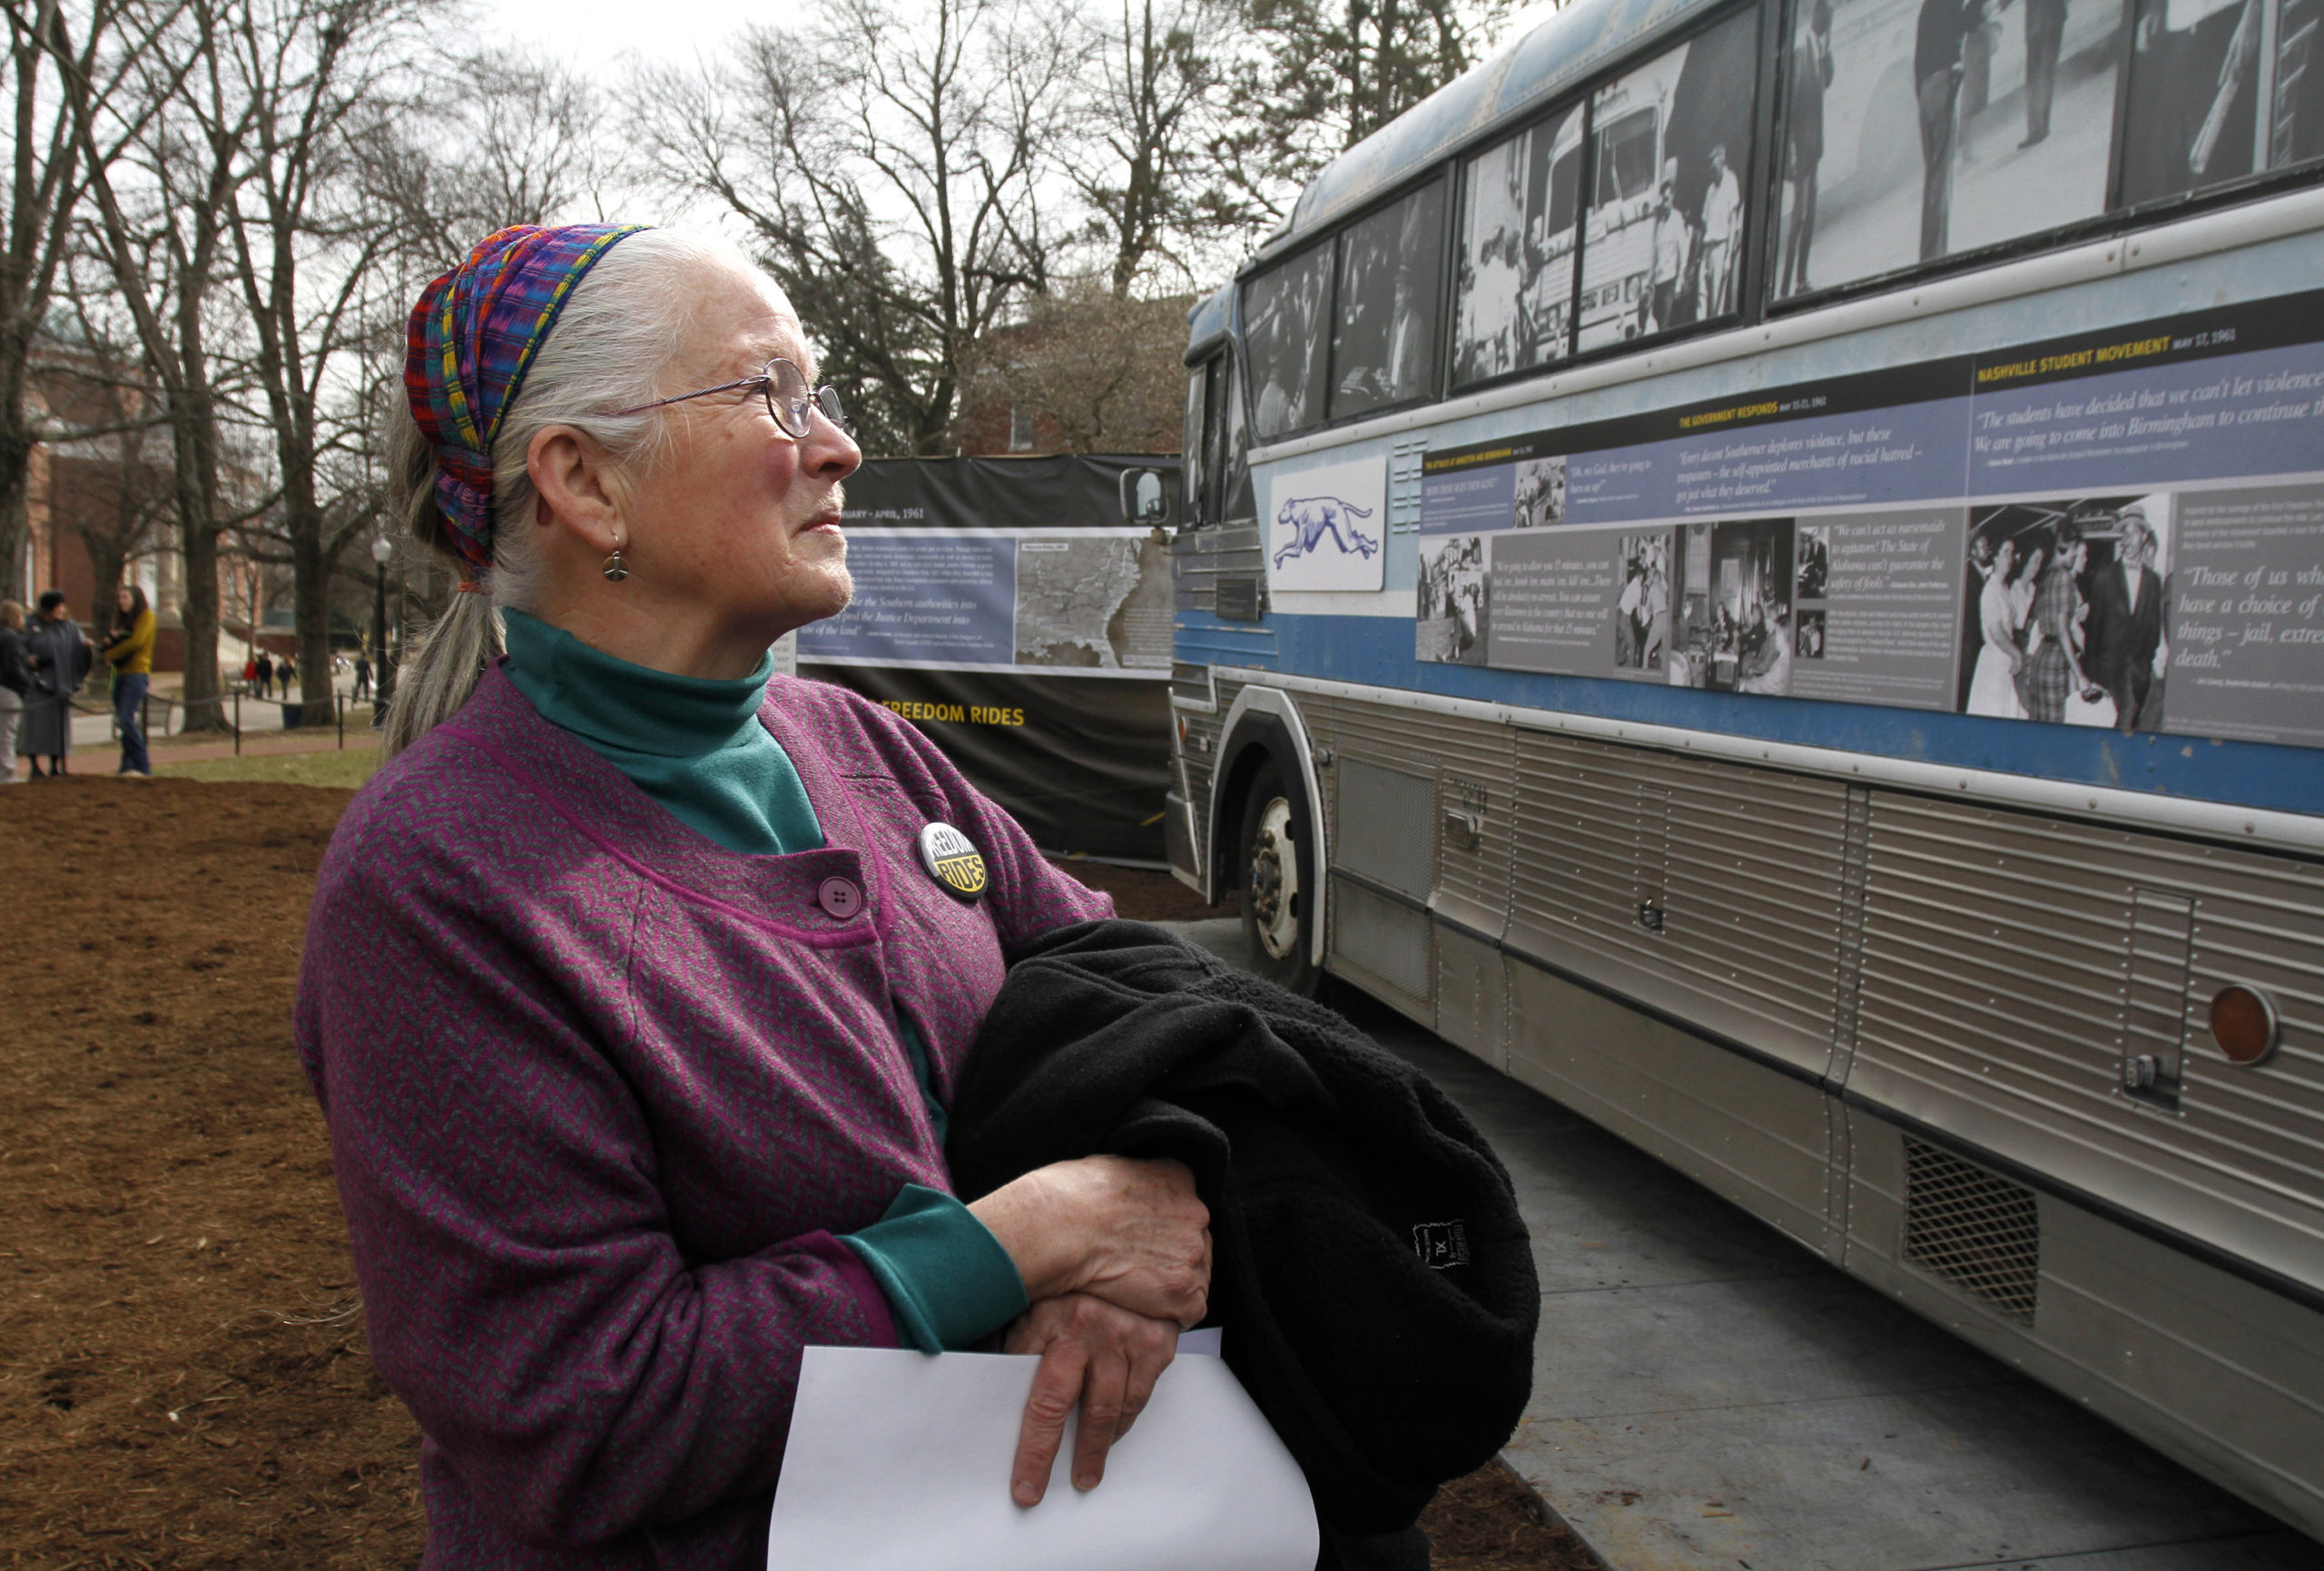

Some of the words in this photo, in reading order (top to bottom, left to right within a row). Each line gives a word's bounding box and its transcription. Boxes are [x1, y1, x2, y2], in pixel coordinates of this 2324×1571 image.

[1978, 359, 2038, 382] NASHVILLE
[2039, 349, 2094, 373] STUDENT
[2095, 336, 2171, 363] MOVEMENT
[2172, 337, 2193, 350] MAY
[2211, 328, 2236, 345] 1961
[2006, 406, 2053, 425] students
[2055, 401, 2084, 419] have
[2085, 390, 2137, 416] decided
[2139, 388, 2166, 407] that
[2169, 389, 2190, 404] we
[2232, 375, 2254, 398] let
[2257, 370, 2324, 392] violence
[1680, 417, 1690, 428] THE
[1692, 408, 1736, 427] GOVERNMENT
[1738, 401, 1778, 418] RESPONDS
[1974, 437, 1992, 452] We
[1993, 438, 2012, 451] are
[2013, 430, 2046, 453] going
[2048, 431, 2061, 446] to
[2063, 427, 2097, 443] come
[2099, 422, 2125, 439] into
[2127, 410, 2215, 436] Birmingham
[2218, 410, 2235, 426] to
[2237, 401, 2309, 425] continue
[1725, 443, 1767, 458] Southerner
[1768, 438, 1803, 456] deplores
[1848, 429, 1865, 444] but
[1866, 427, 1892, 442] these
[1732, 457, 1787, 479] self-appointed
[1788, 454, 1835, 470] merchants
[1837, 450, 1850, 470] of
[1850, 447, 1879, 465] racial
[1881, 443, 1915, 462] hatred
[902, 507, 924, 519] 1961
[1873, 525, 1886, 535] act
[1887, 525, 1896, 535] as
[1898, 518, 1945, 533] nursemaids
[1881, 539, 1896, 554] The
[1898, 539, 1918, 553] State
[1920, 537, 1932, 555] of
[1831, 558, 1866, 572] Alabama
[1888, 559, 1928, 574] guarantee
[1931, 555, 1946, 571] the
[1830, 576, 1854, 592] safety
[1854, 575, 1865, 592] of
[2244, 565, 2266, 590] of
[2268, 571, 2289, 585] us
[880, 597, 913, 609] Southern
[915, 597, 960, 611] authorities
[960, 597, 977, 611] into
[2179, 594, 2216, 614] have
[2221, 599, 2232, 614] a
[2239, 594, 2293, 614] choice
[2298, 594, 2322, 620] of
[874, 612, 901, 624] Justice
[903, 613, 951, 625] Department
[952, 614, 970, 625] into
[2177, 620, 2224, 645] things
[2239, 622, 2274, 646] jail,
[2280, 628, 2324, 643] extre
[970, 706, 1024, 726] RIDES
[938, 857, 984, 889] RIDES
[1435, 1241, 1447, 1257] XL
